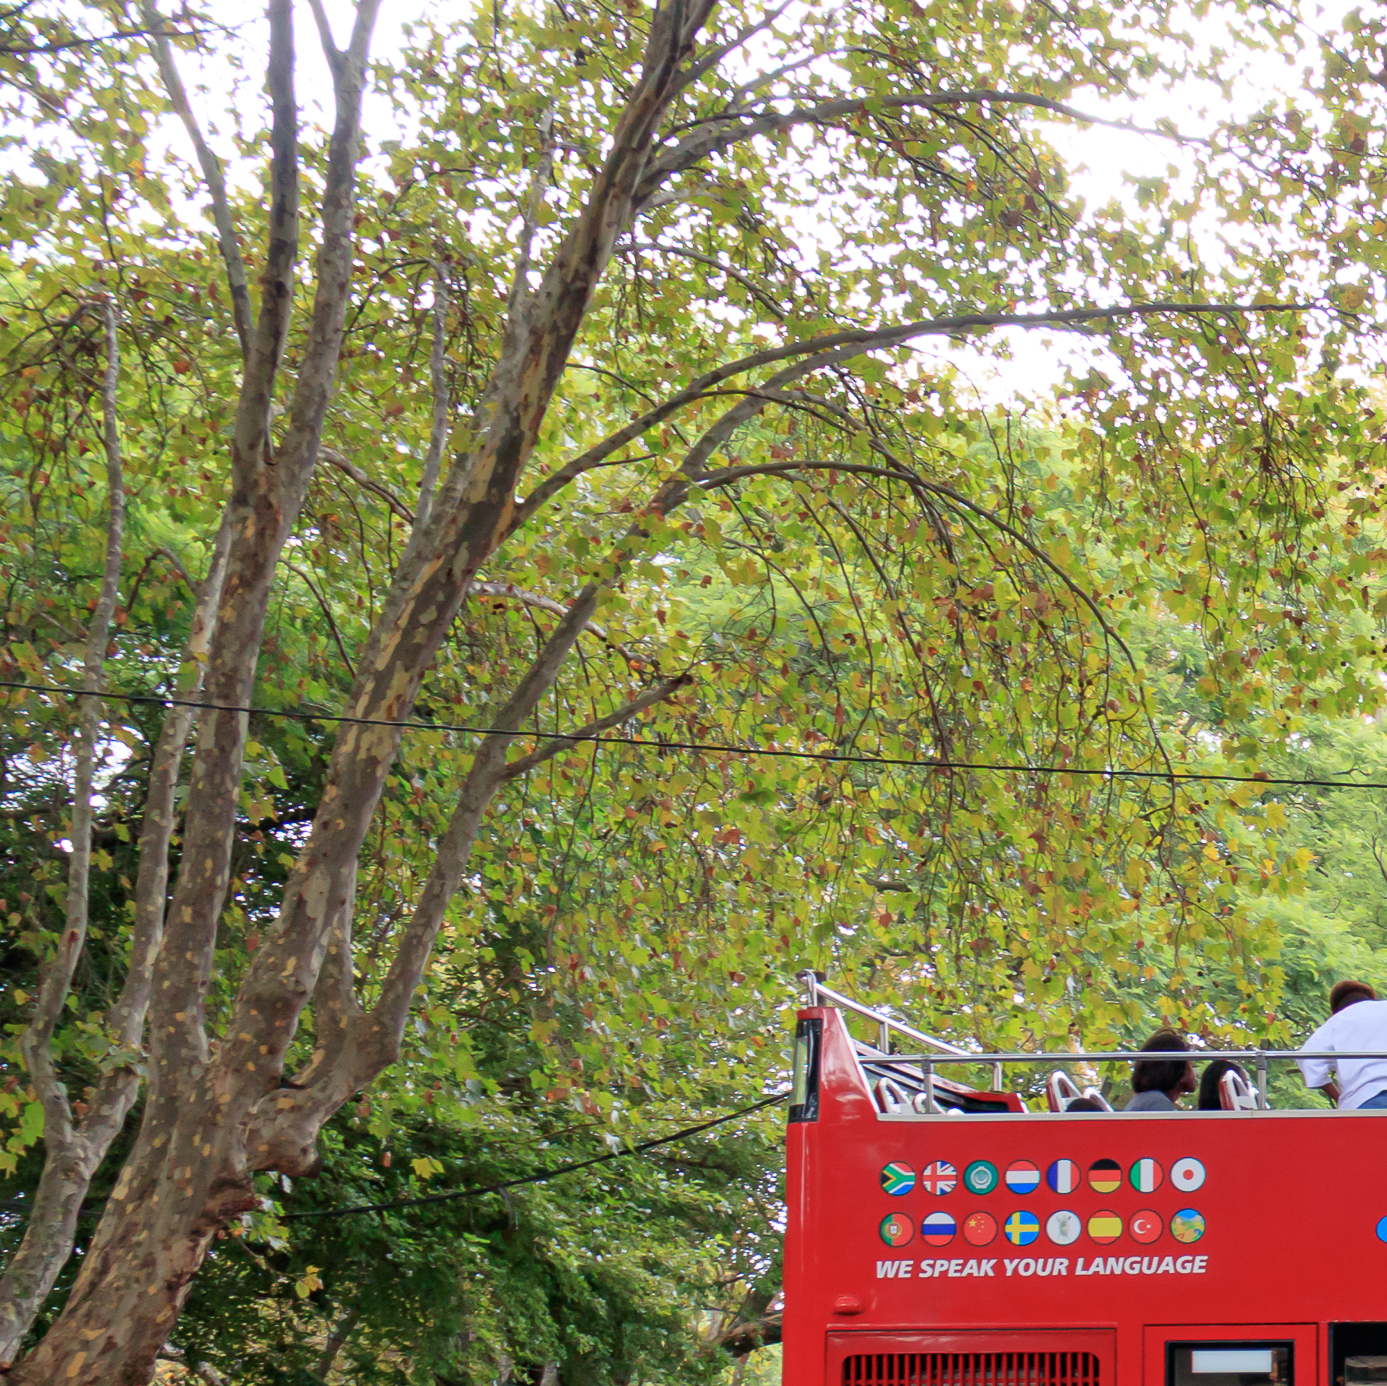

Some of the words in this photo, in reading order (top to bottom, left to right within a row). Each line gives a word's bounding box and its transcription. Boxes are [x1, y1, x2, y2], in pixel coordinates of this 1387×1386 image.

[876, 1259, 914, 1279] WE
[919, 1258, 998, 1278] SPEAK
[1003, 1257, 1069, 1277] YOUR
[1075, 1255, 1209, 1276] LANGUAGE
